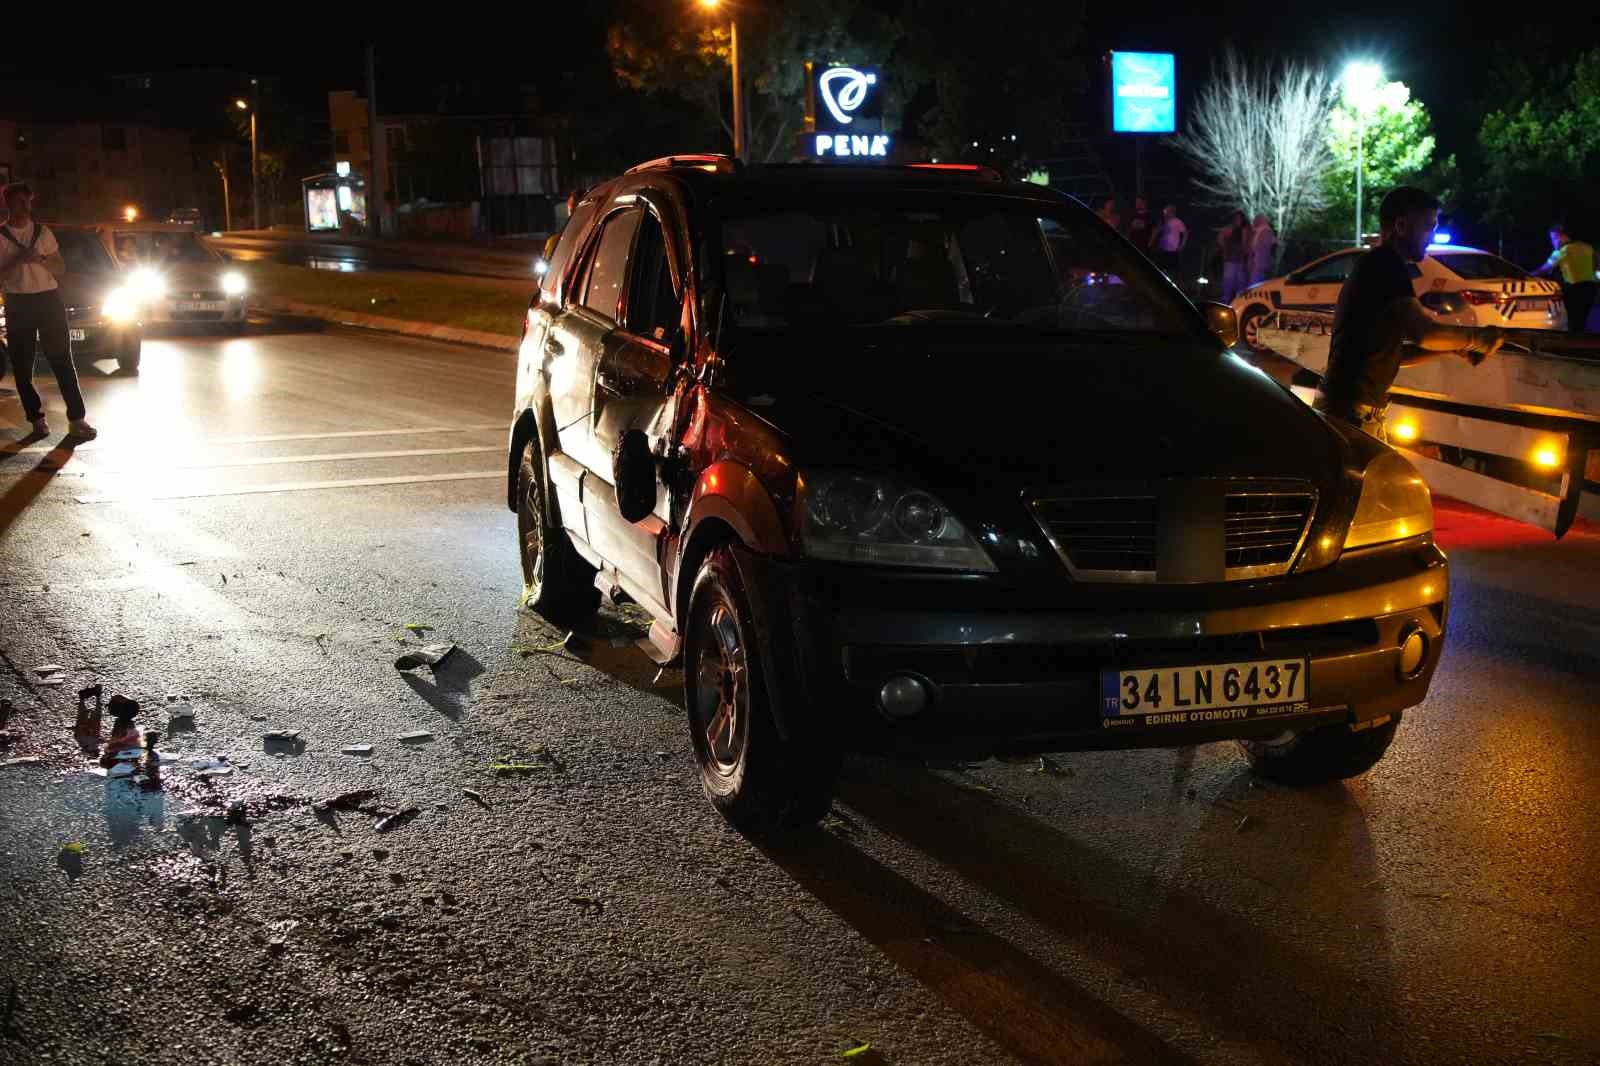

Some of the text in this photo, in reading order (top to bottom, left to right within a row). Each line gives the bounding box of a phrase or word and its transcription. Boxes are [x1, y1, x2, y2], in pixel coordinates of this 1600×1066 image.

[816, 134, 889, 156] PENA
[1122, 663, 1301, 710] 34 LN 6437
[1104, 697, 1120, 709] TR
